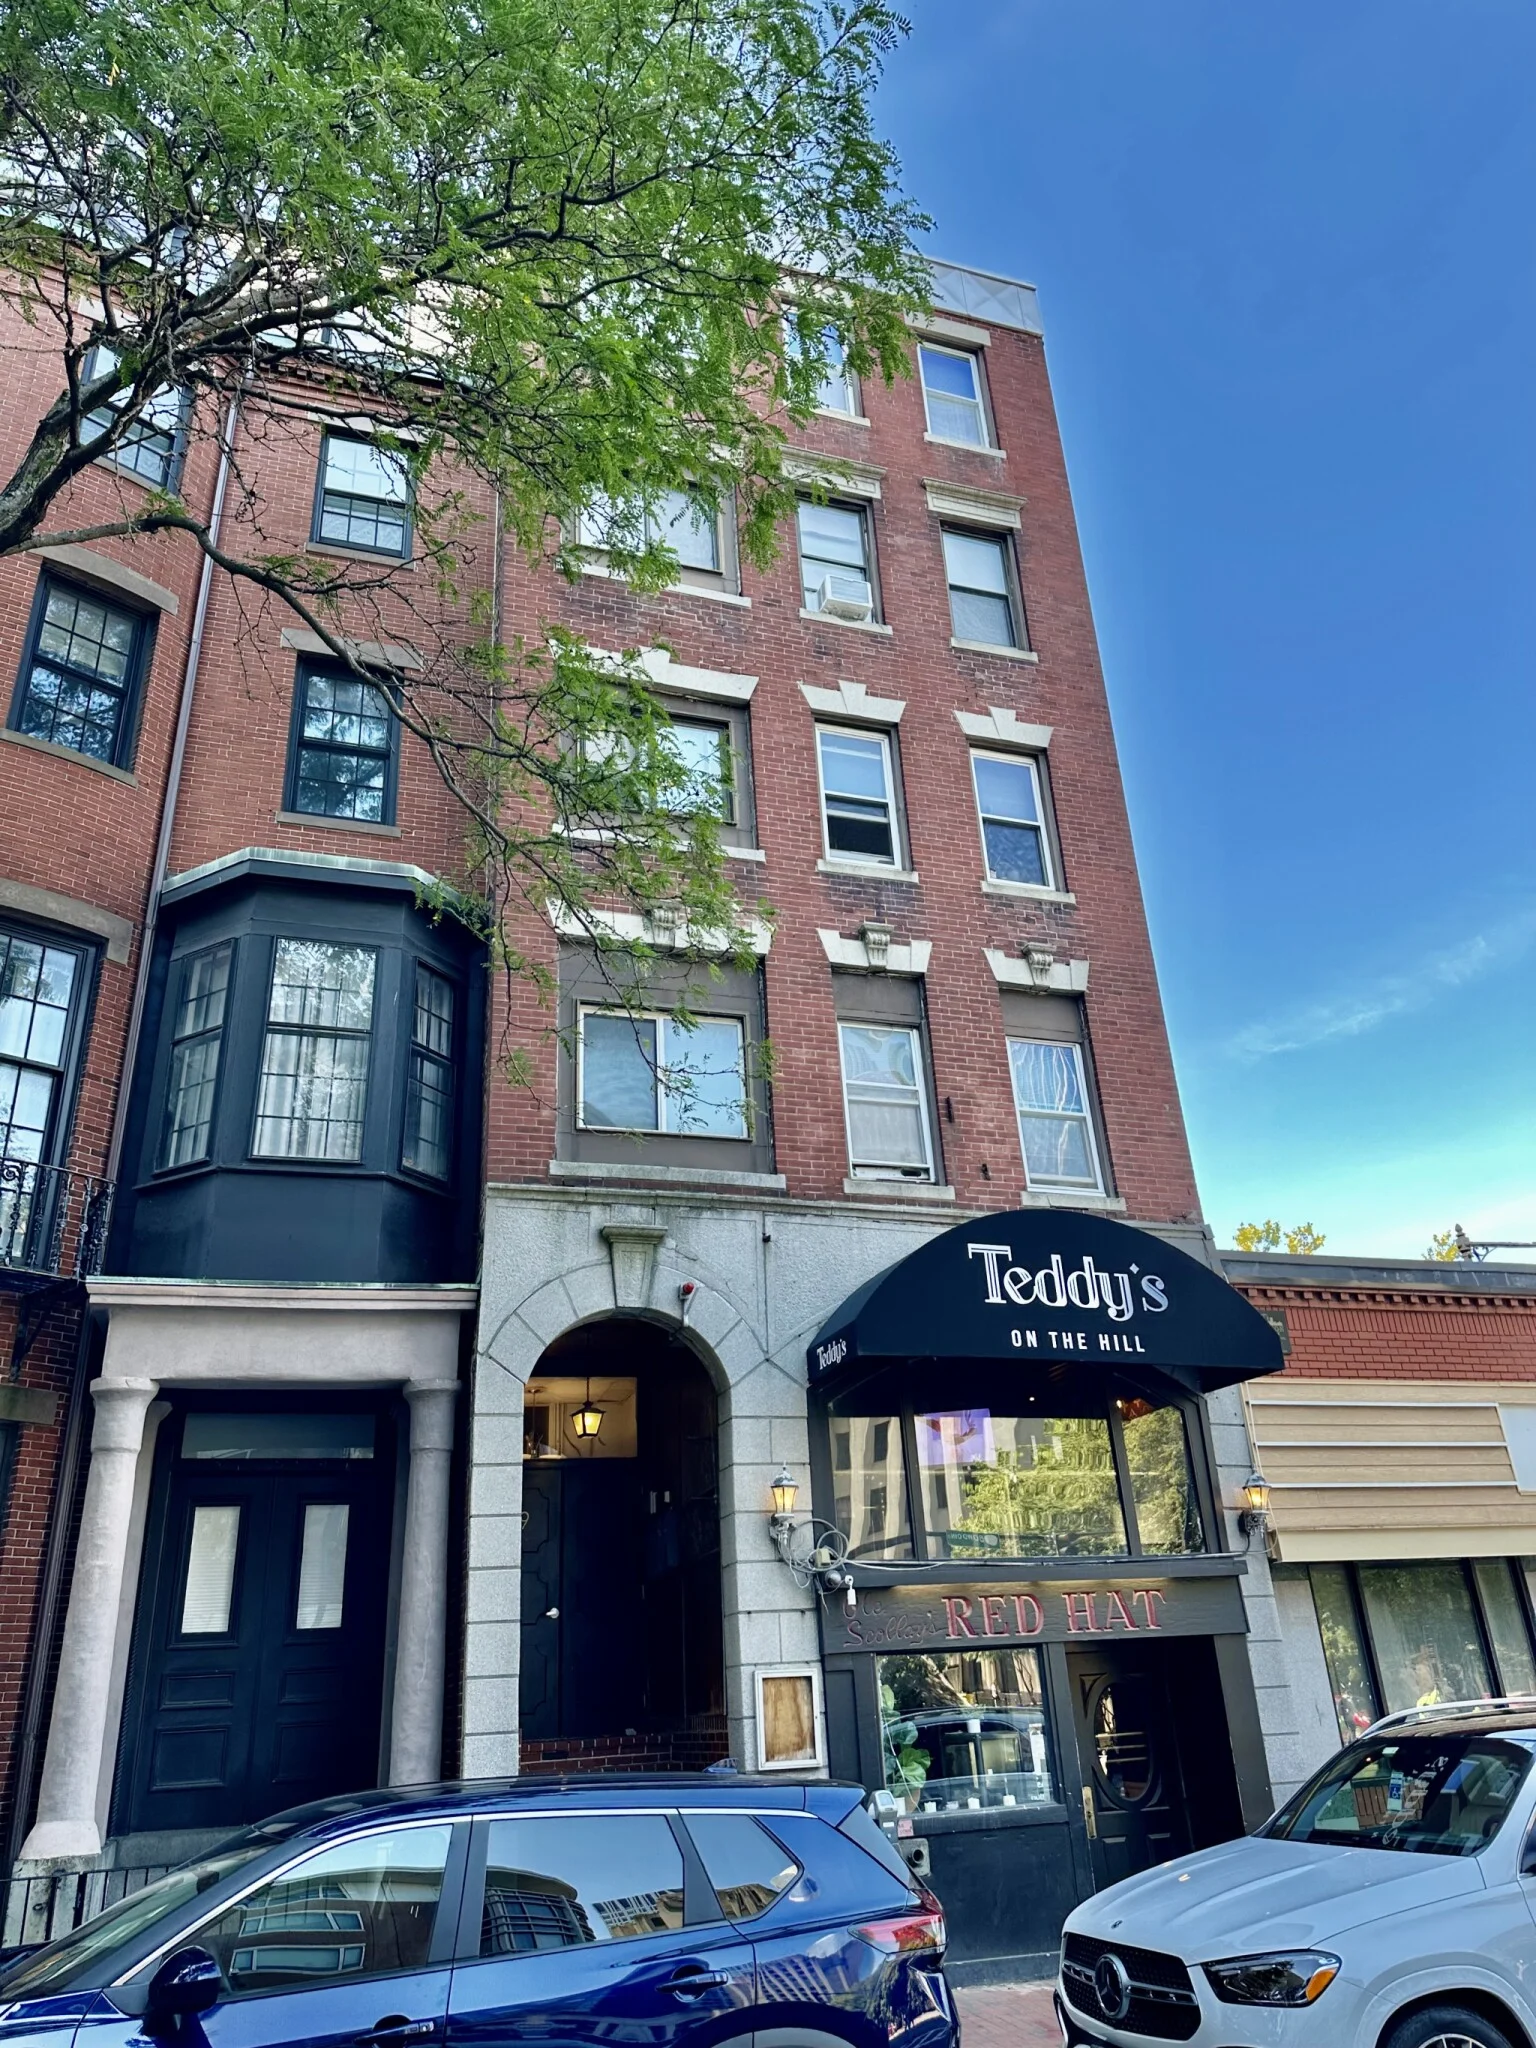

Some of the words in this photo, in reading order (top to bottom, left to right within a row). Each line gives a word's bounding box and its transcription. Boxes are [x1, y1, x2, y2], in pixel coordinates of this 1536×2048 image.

[967, 1243, 1169, 1321] Teddy's
[816, 1338, 847, 1370] Teddy's
[1011, 1329, 1038, 1348] ON
[1048, 1331, 1088, 1350] THE
[1098, 1333, 1146, 1353] HILL
[941, 1593, 1045, 1640] RED
[1061, 1589, 1167, 1633] HAT
